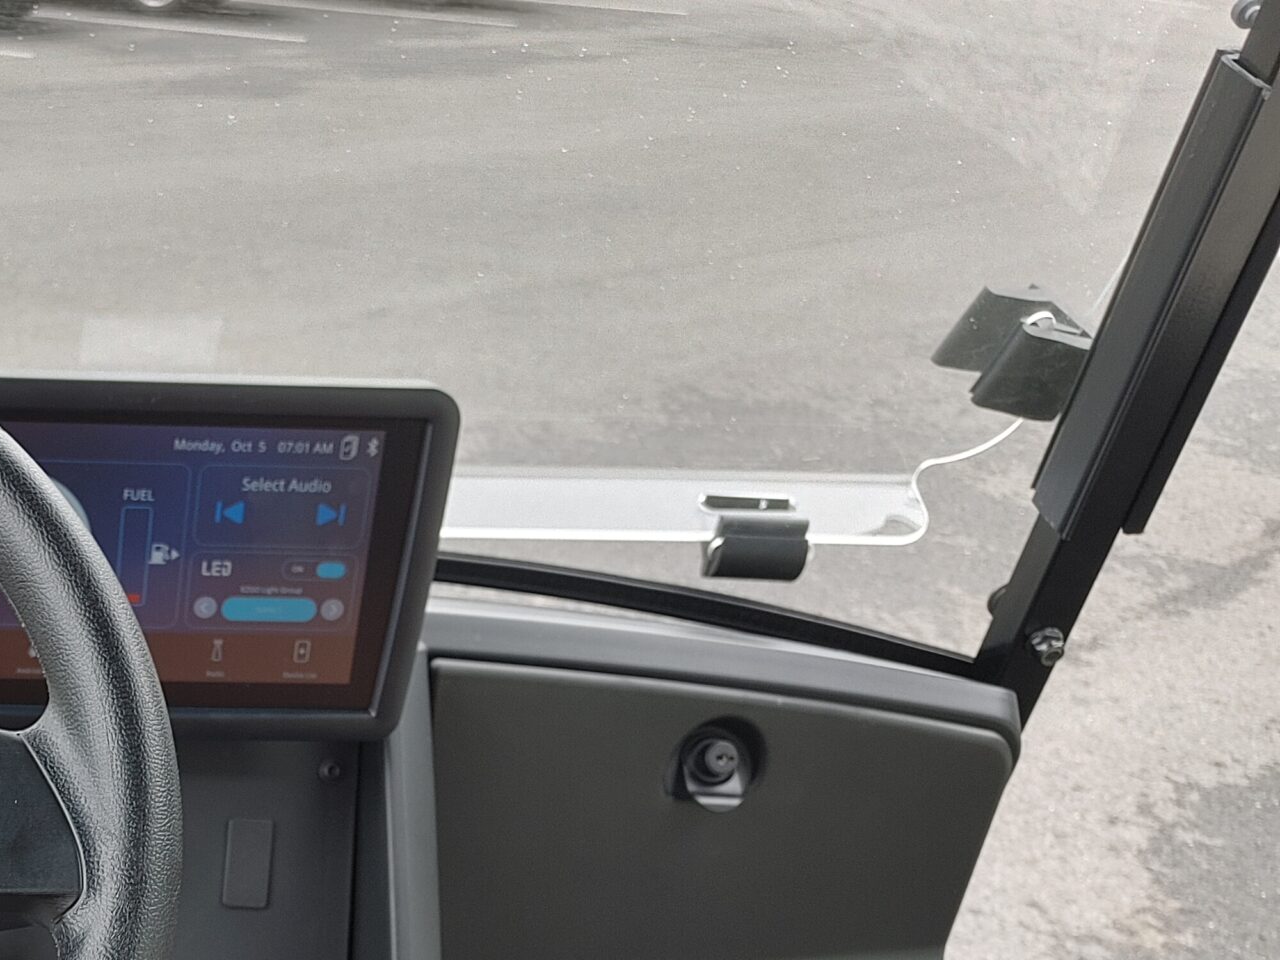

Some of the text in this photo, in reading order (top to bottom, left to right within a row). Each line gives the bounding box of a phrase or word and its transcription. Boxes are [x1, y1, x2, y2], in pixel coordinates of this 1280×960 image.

[173, 438, 334, 455] Monday, Oct 5 07:01 AM
[242, 476, 332, 494] Select Audio
[123, 488, 155, 502] FUEL
[201, 560, 232, 577] LED
